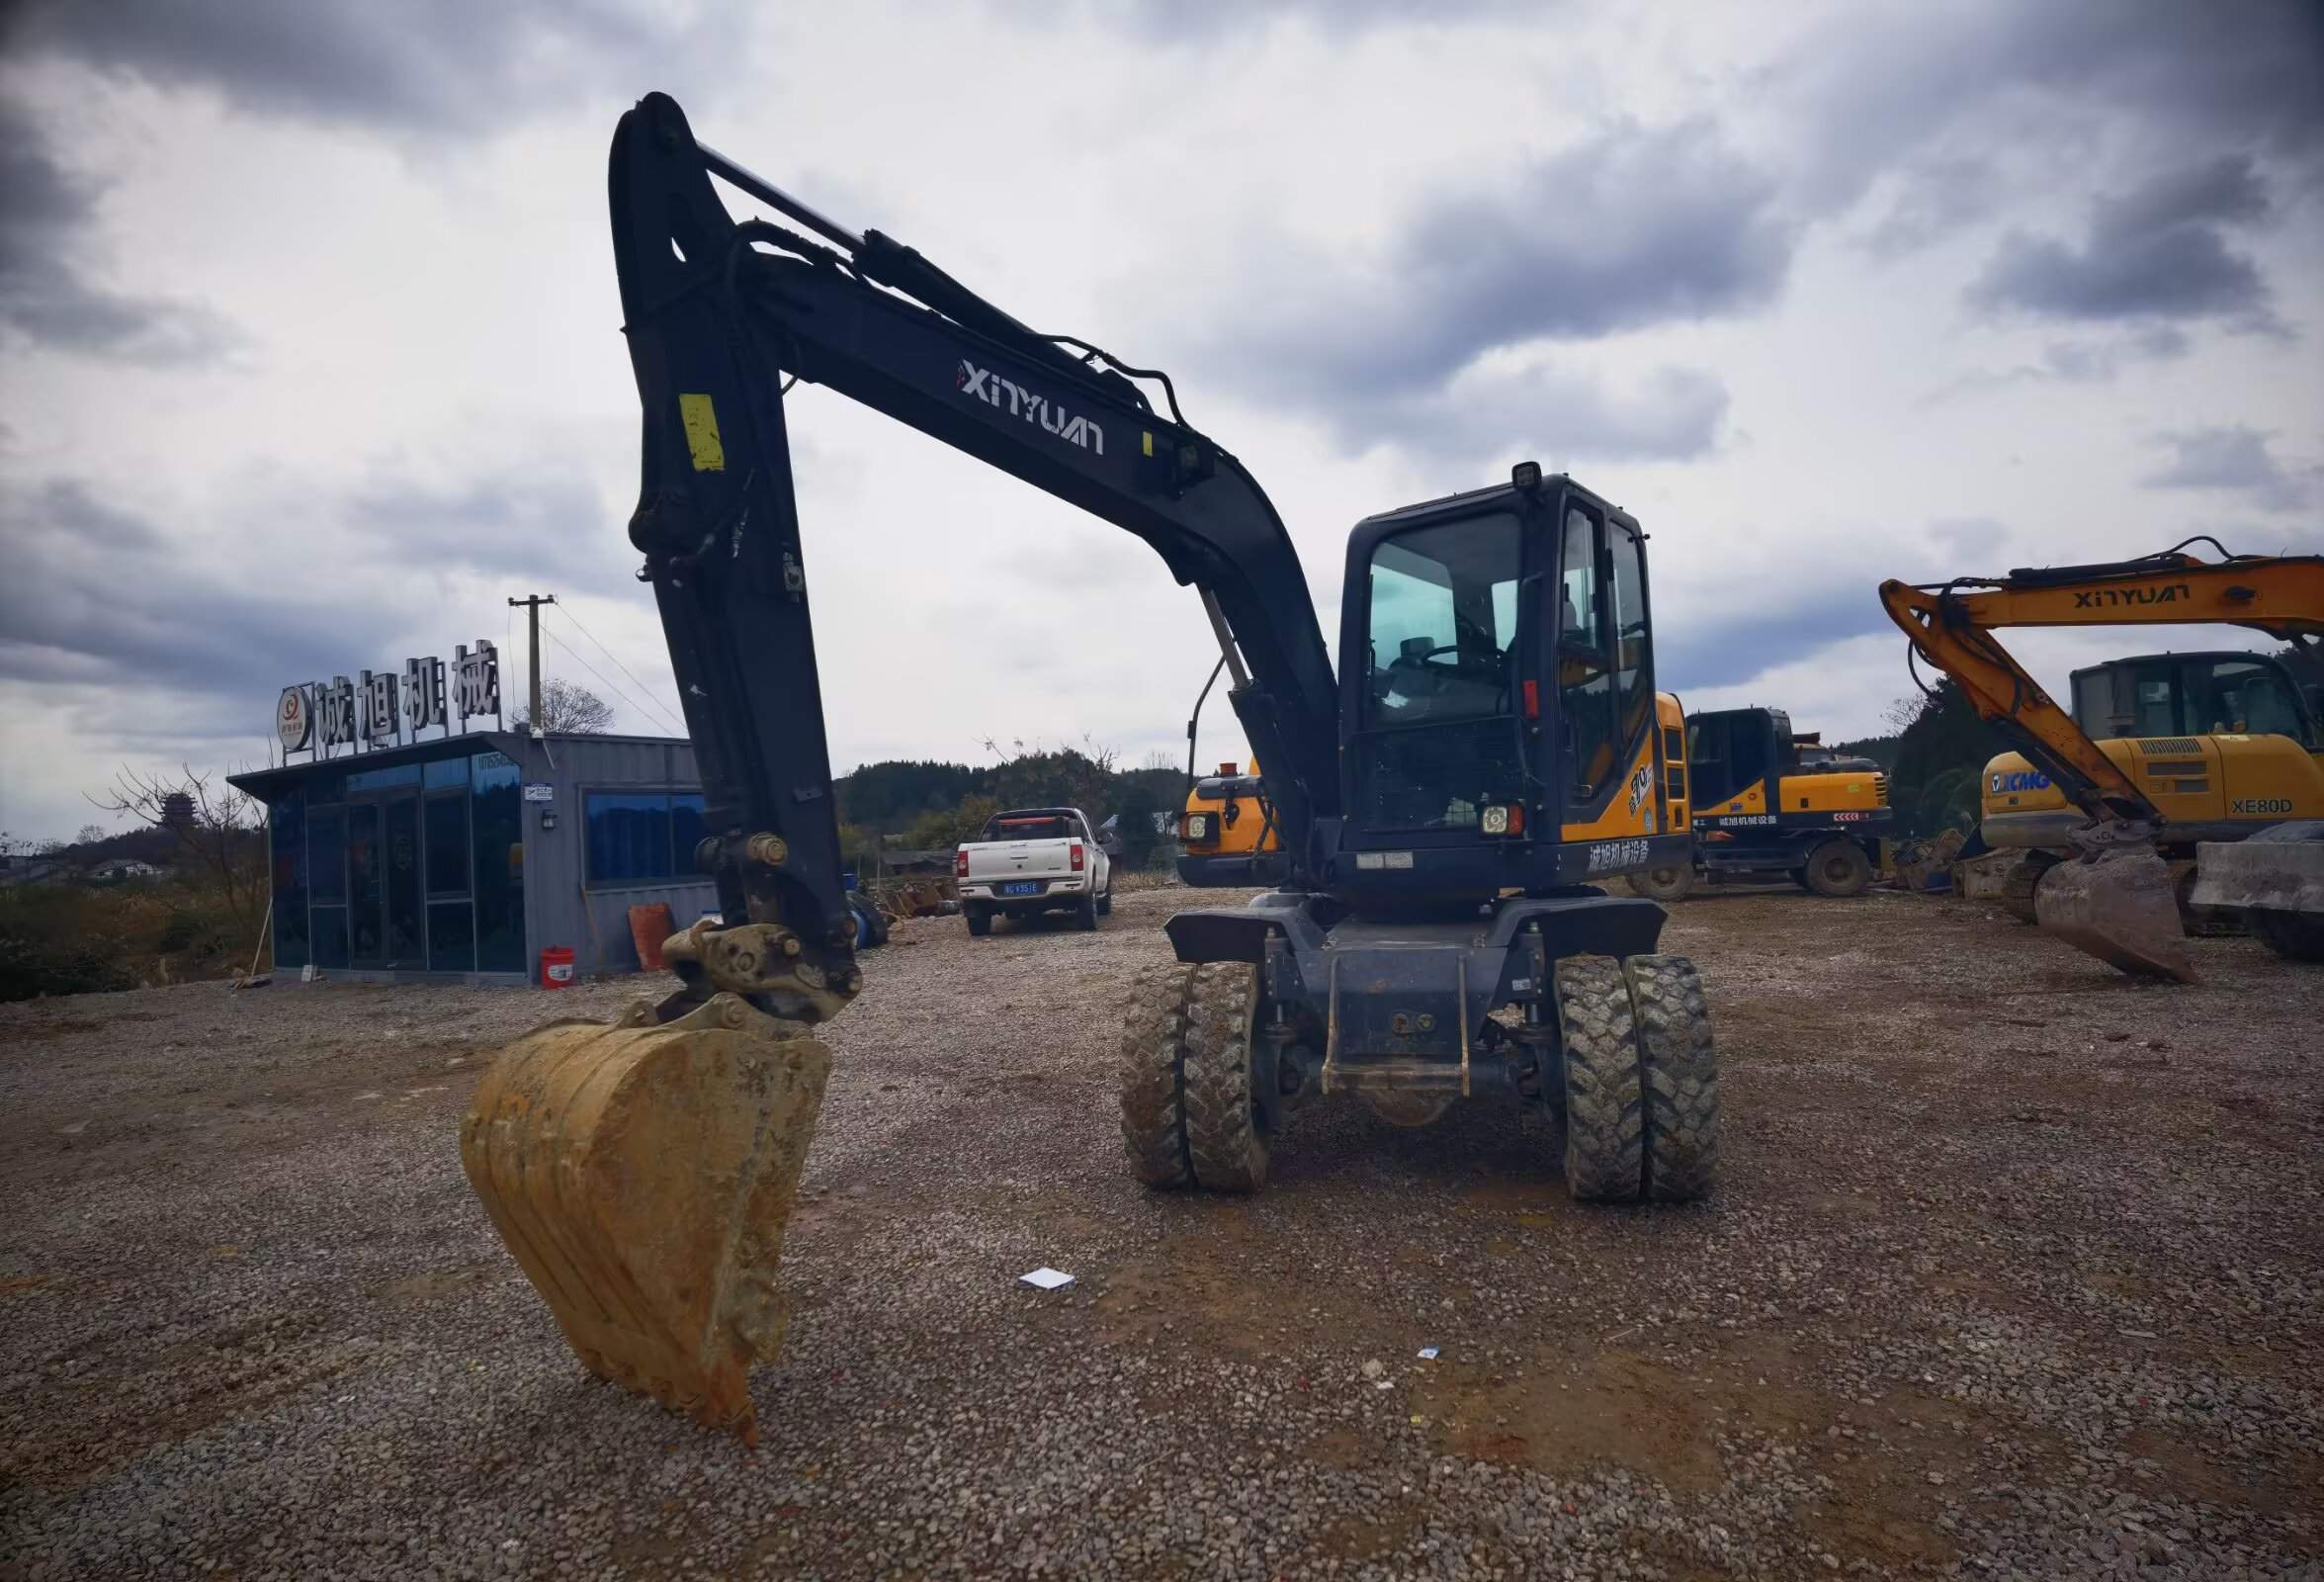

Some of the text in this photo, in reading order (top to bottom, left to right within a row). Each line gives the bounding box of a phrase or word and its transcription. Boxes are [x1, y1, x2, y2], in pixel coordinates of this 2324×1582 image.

[315, 639, 498, 746] 诚旭机械
[2231, 798, 2293, 814] XE80D
